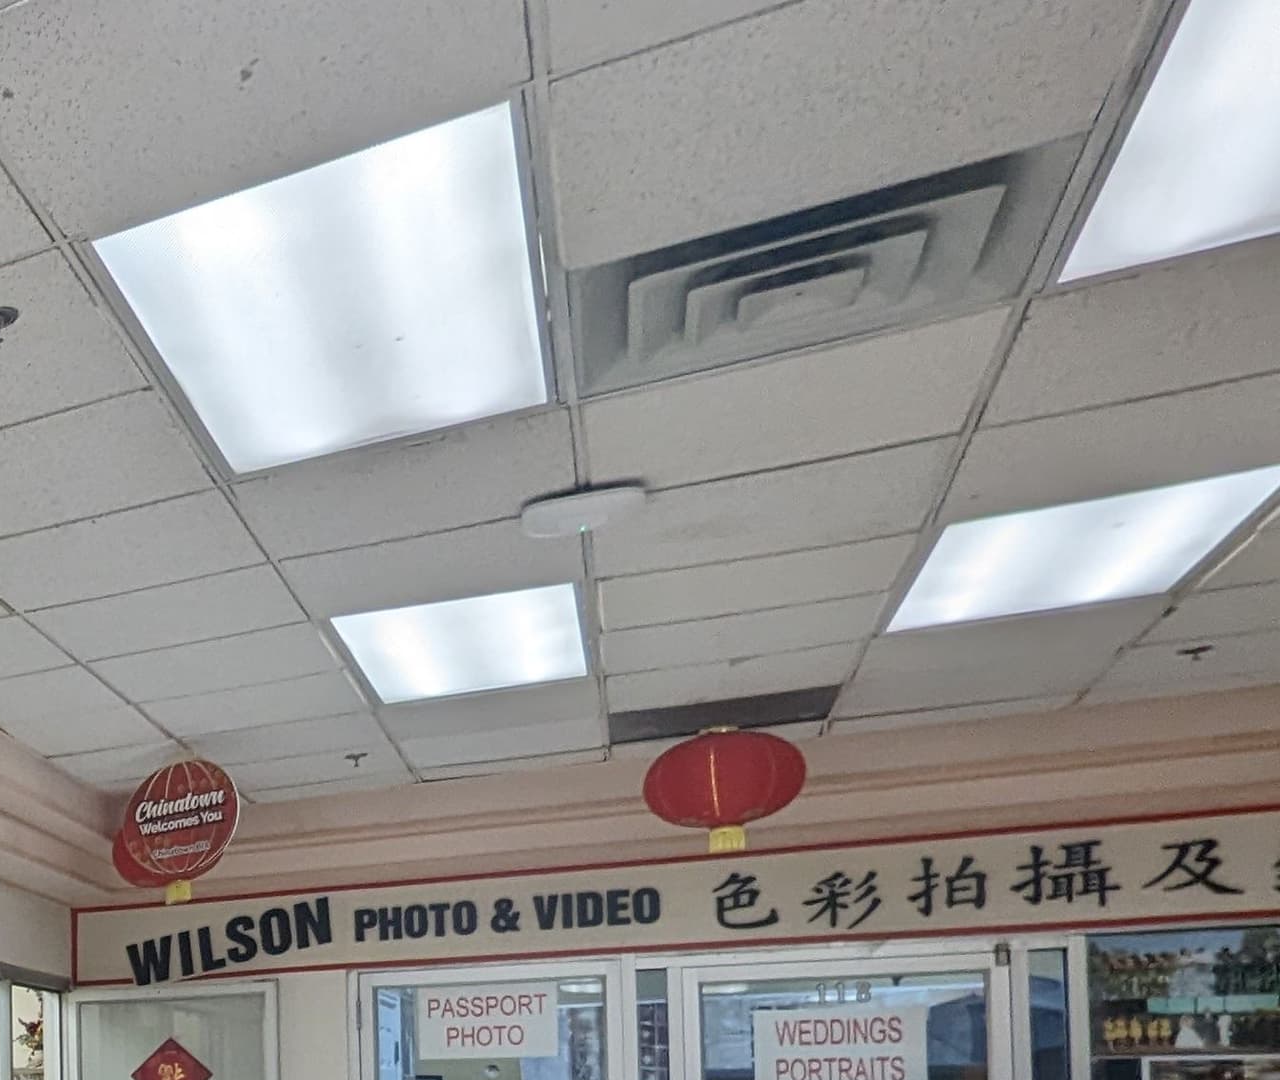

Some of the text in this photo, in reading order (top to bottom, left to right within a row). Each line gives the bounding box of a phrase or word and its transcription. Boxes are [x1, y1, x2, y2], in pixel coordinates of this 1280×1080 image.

[135, 790, 226, 823] Chinatown
[139, 810, 223, 836] Welcomes You
[712, 837, 1280, 930] 色彩拍攝及
[126, 887, 661, 986] WILSON PHOTO & VIDEO
[427, 994, 547, 1019] PASSPORT
[815, 982, 872, 1004] 118
[446, 1025, 524, 1047] PHOTO
[775, 1016, 903, 1045] WEDDINGS
